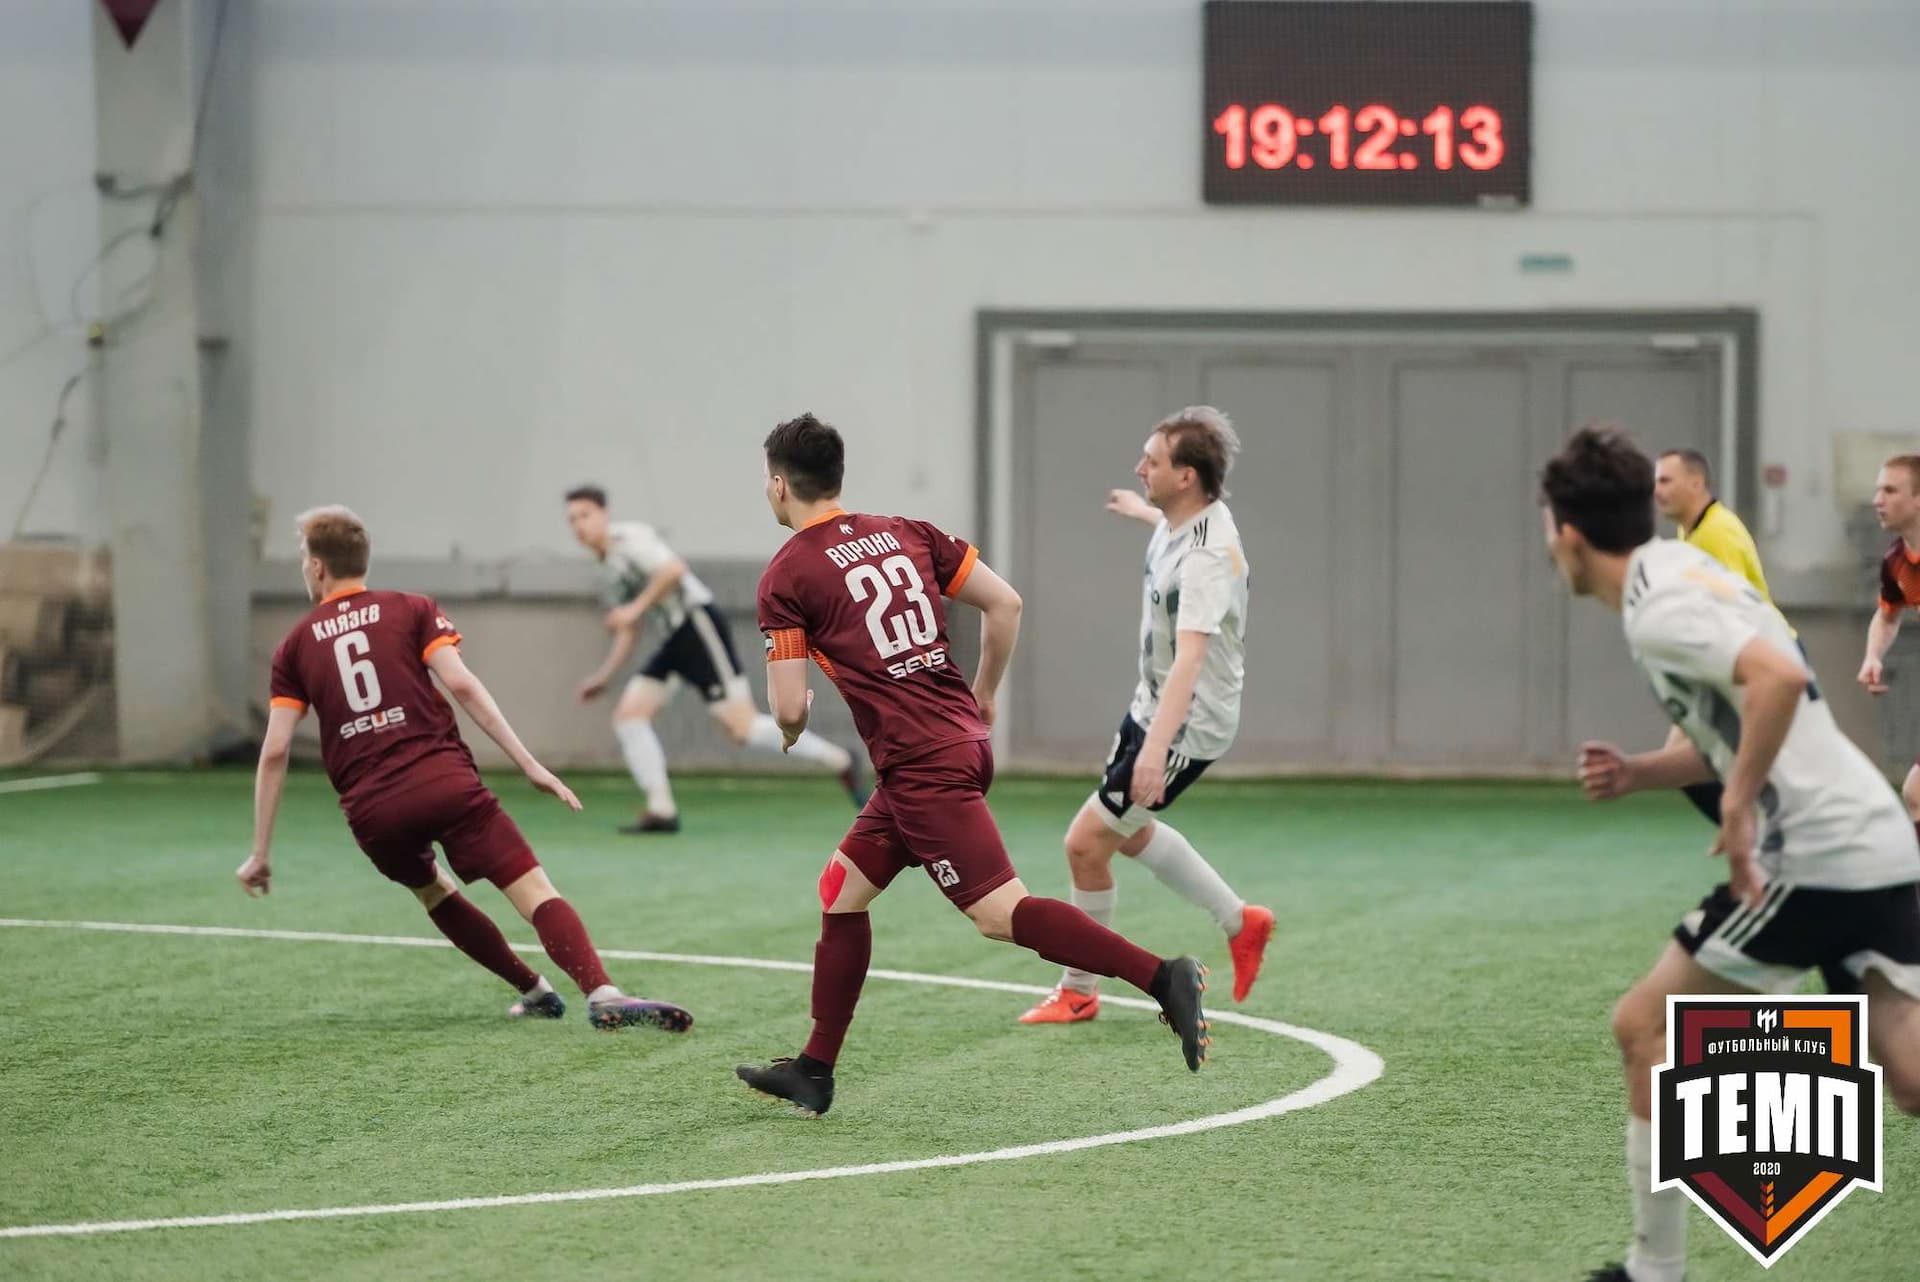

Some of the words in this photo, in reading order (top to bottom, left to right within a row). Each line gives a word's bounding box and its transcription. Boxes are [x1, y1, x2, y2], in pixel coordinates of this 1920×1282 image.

[1213, 103, 1504, 171] 19:12:13
[825, 532, 901, 569] ВОРОНА
[312, 604, 380, 642] КНЯЗЕВ
[845, 555, 938, 659] 23
[333, 630, 382, 713] 6
[340, 706, 405, 739] SEUS
[931, 859, 961, 888] 23
